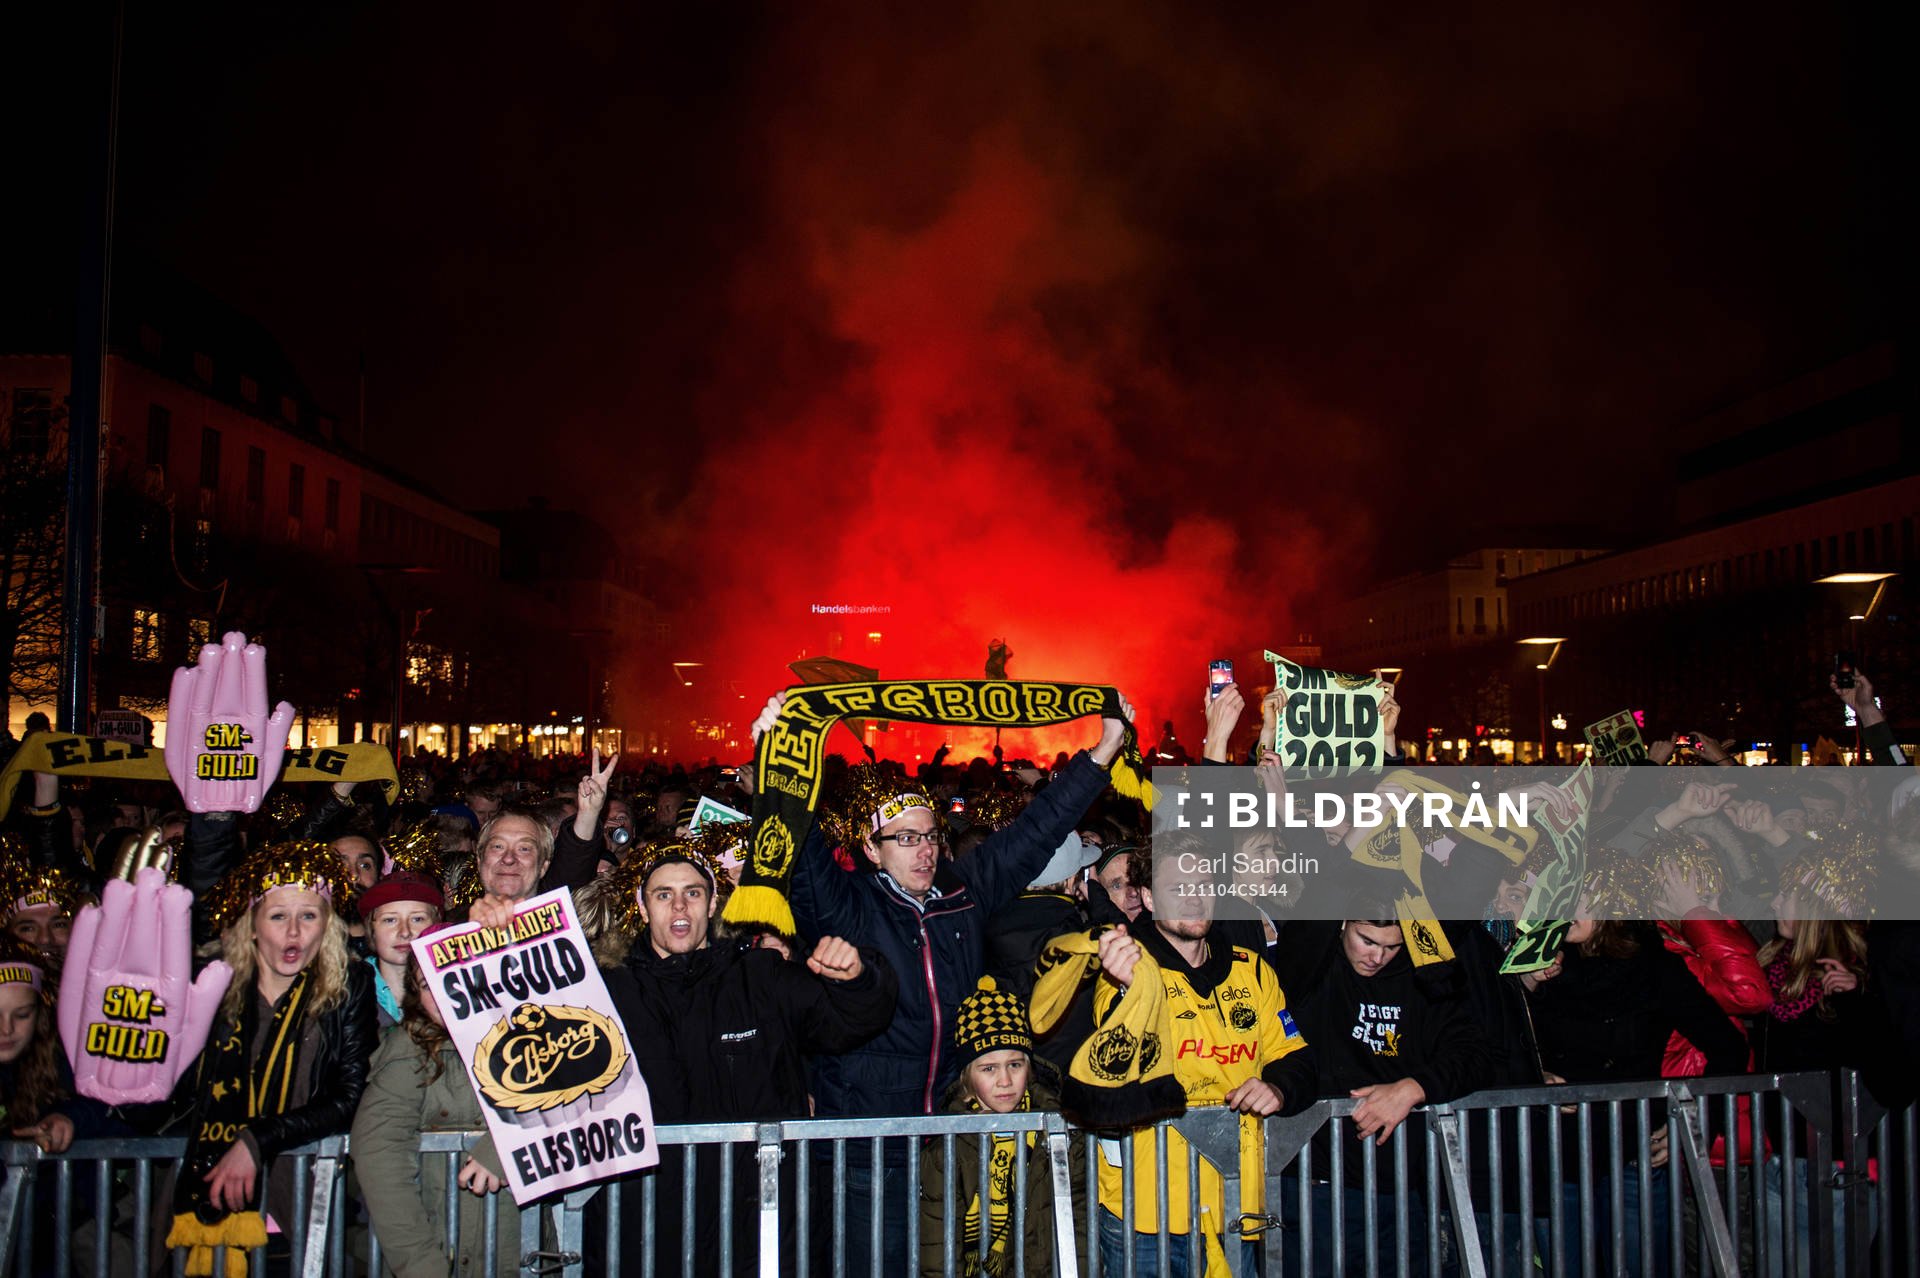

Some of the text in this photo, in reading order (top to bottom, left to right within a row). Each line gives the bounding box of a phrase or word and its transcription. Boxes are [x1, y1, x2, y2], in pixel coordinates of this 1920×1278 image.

[811, 603, 891, 615] Handelsbanken
[1285, 691, 1379, 738] GULD
[205, 723, 253, 751] SM-
[197, 753, 259, 781] GULD
[1284, 738, 1376, 779] 2012
[443, 937, 586, 1021] SM-GULD
[1221, 985, 1251, 1002] ellos
[103, 985, 167, 1025] SM-
[85, 1022, 170, 1064] GULD
[501, 1022, 600, 1092] Elfsborg
[512, 1112, 646, 1187] ELFSBORG
